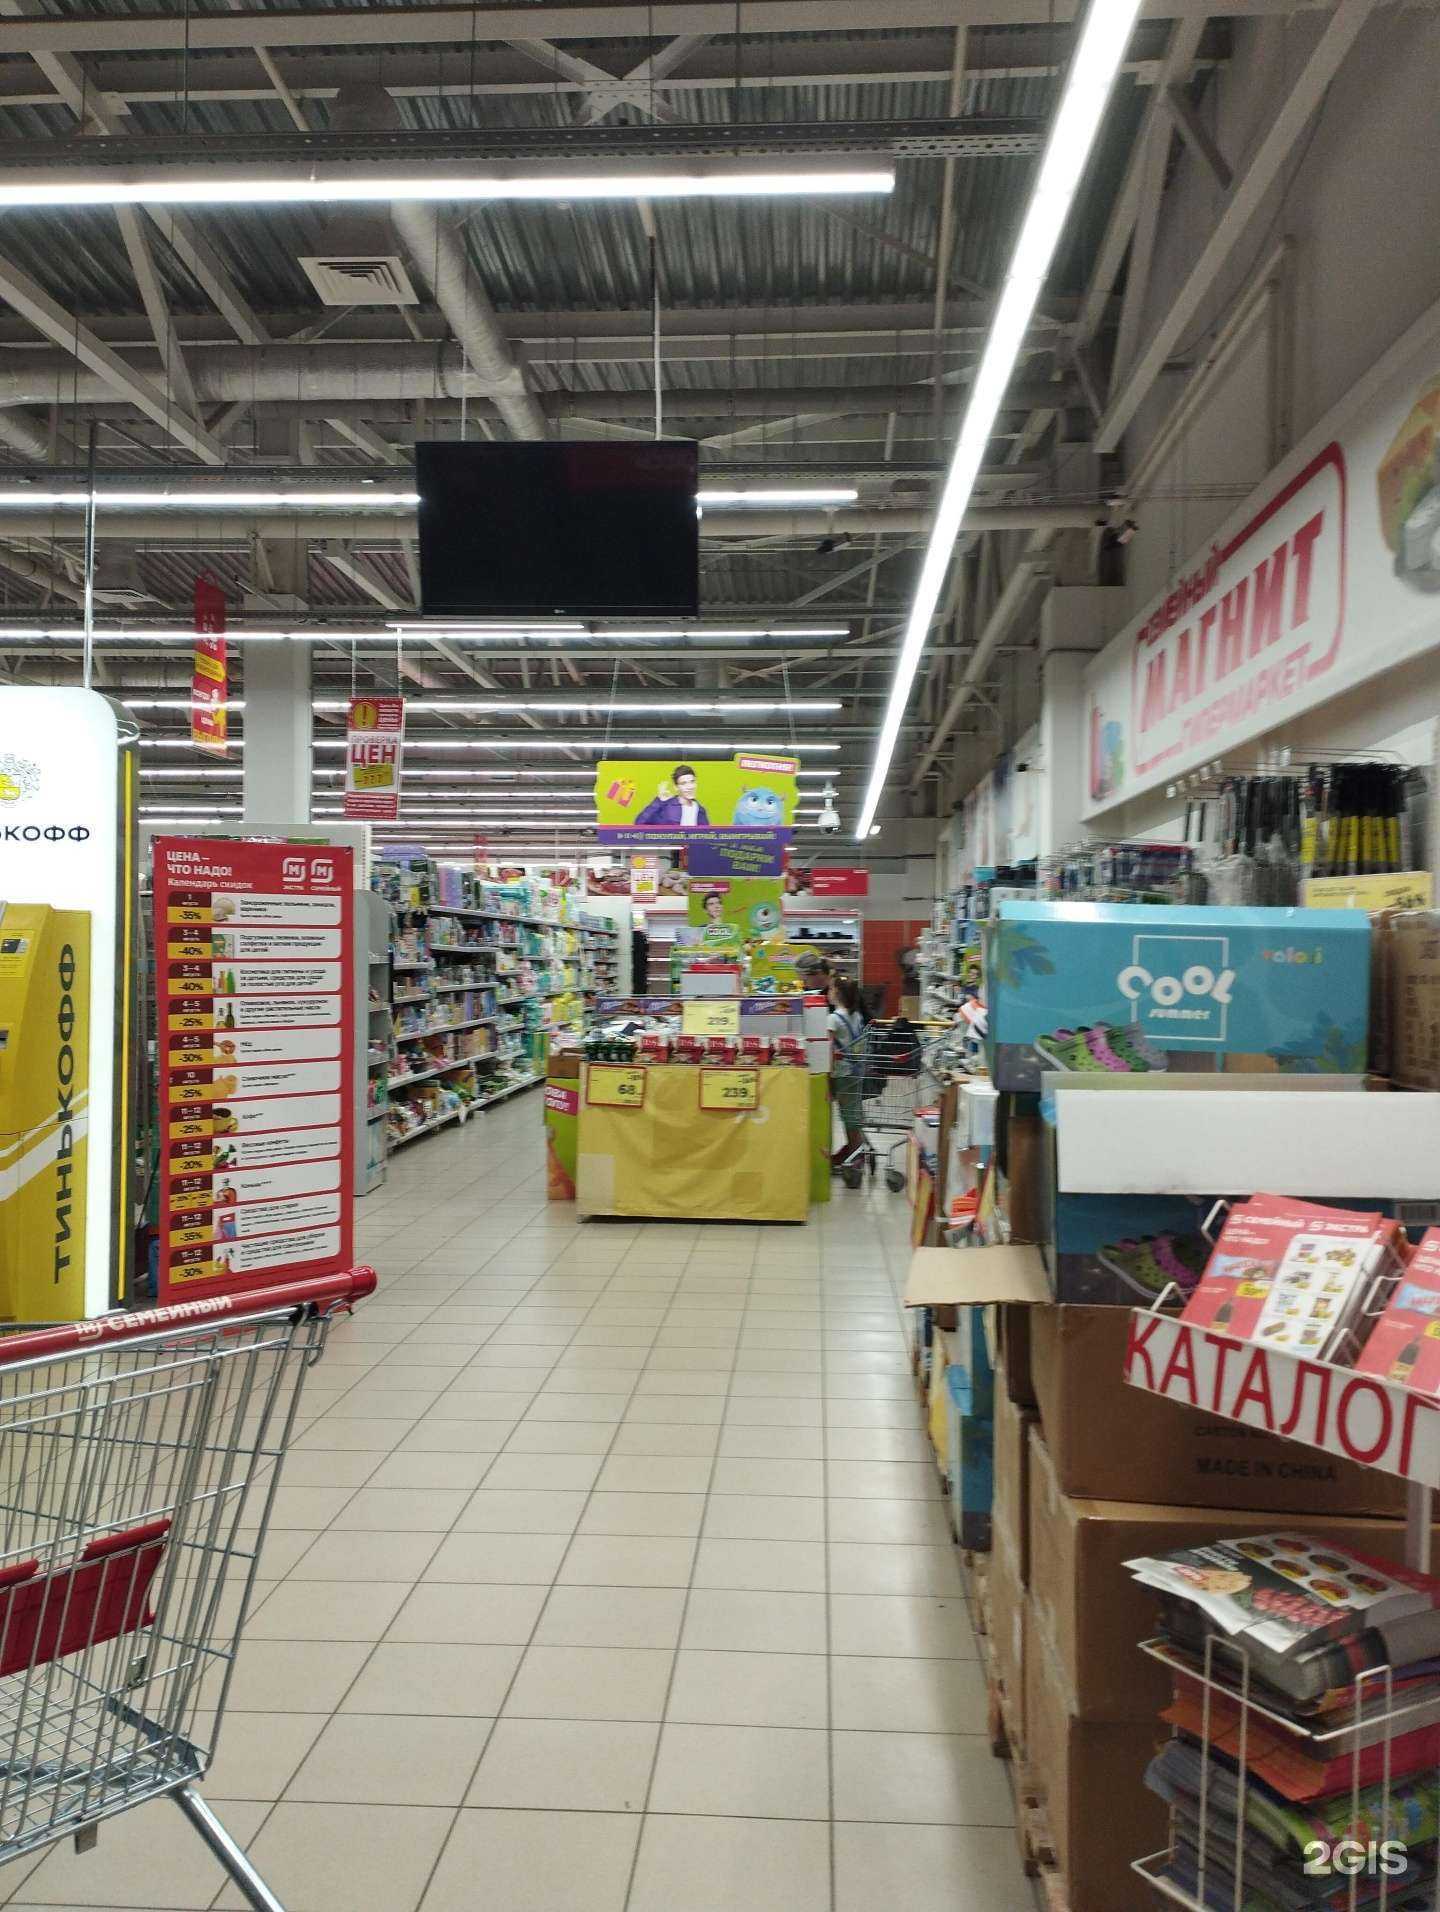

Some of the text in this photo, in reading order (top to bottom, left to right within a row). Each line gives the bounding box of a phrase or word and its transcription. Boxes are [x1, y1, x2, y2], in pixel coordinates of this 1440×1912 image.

[1138, 510, 1324, 733] МАГНИТ
[351, 744, 396, 767] ЦЕН
[167, 850, 200, 862] ЦЕНА
[167, 863, 232, 877] ЧТО НАДО!
[167, 878, 217, 889] Календарь
[1117, 965, 1236, 1006] COOL
[54, 943, 75, 1284] ТИНЬКОФФ
[108, 1295, 233, 1331] СЕМЕЙНЫЙ
[1125, 1313, 1440, 1477] КАТАЛОГ
